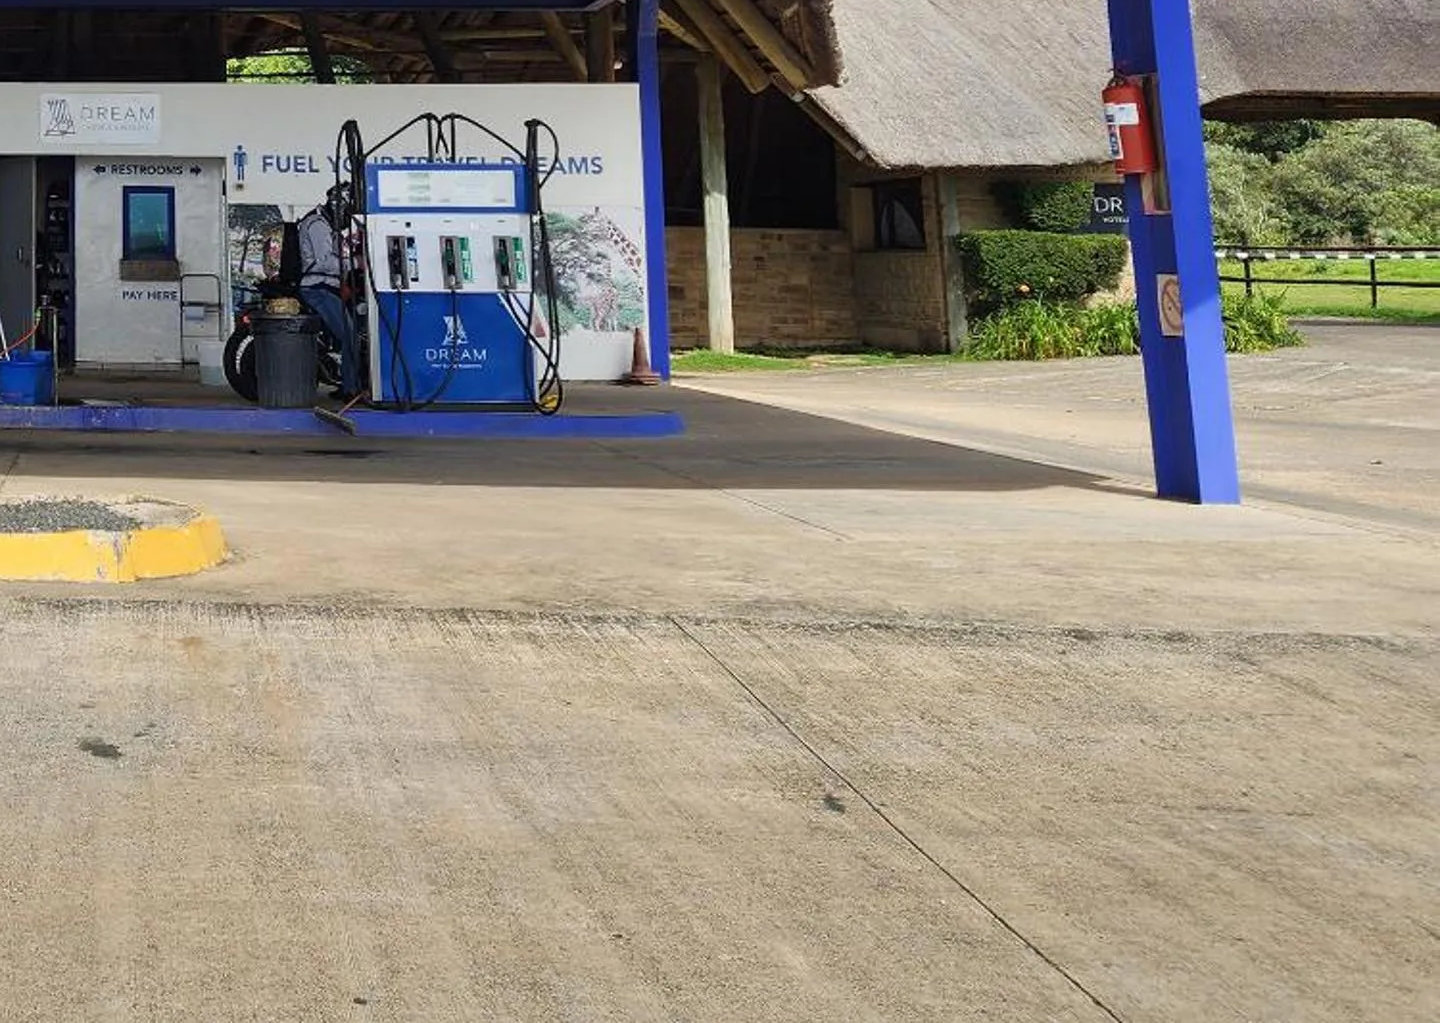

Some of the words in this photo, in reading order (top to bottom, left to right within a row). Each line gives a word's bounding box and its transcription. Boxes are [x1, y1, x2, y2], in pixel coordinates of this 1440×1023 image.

[81, 106, 155, 121] DREAM
[111, 164, 183, 175] RESTROOMS
[262, 156, 320, 173] FUEL
[122, 291, 142, 300] PAY
[147, 291, 178, 301] HERE
